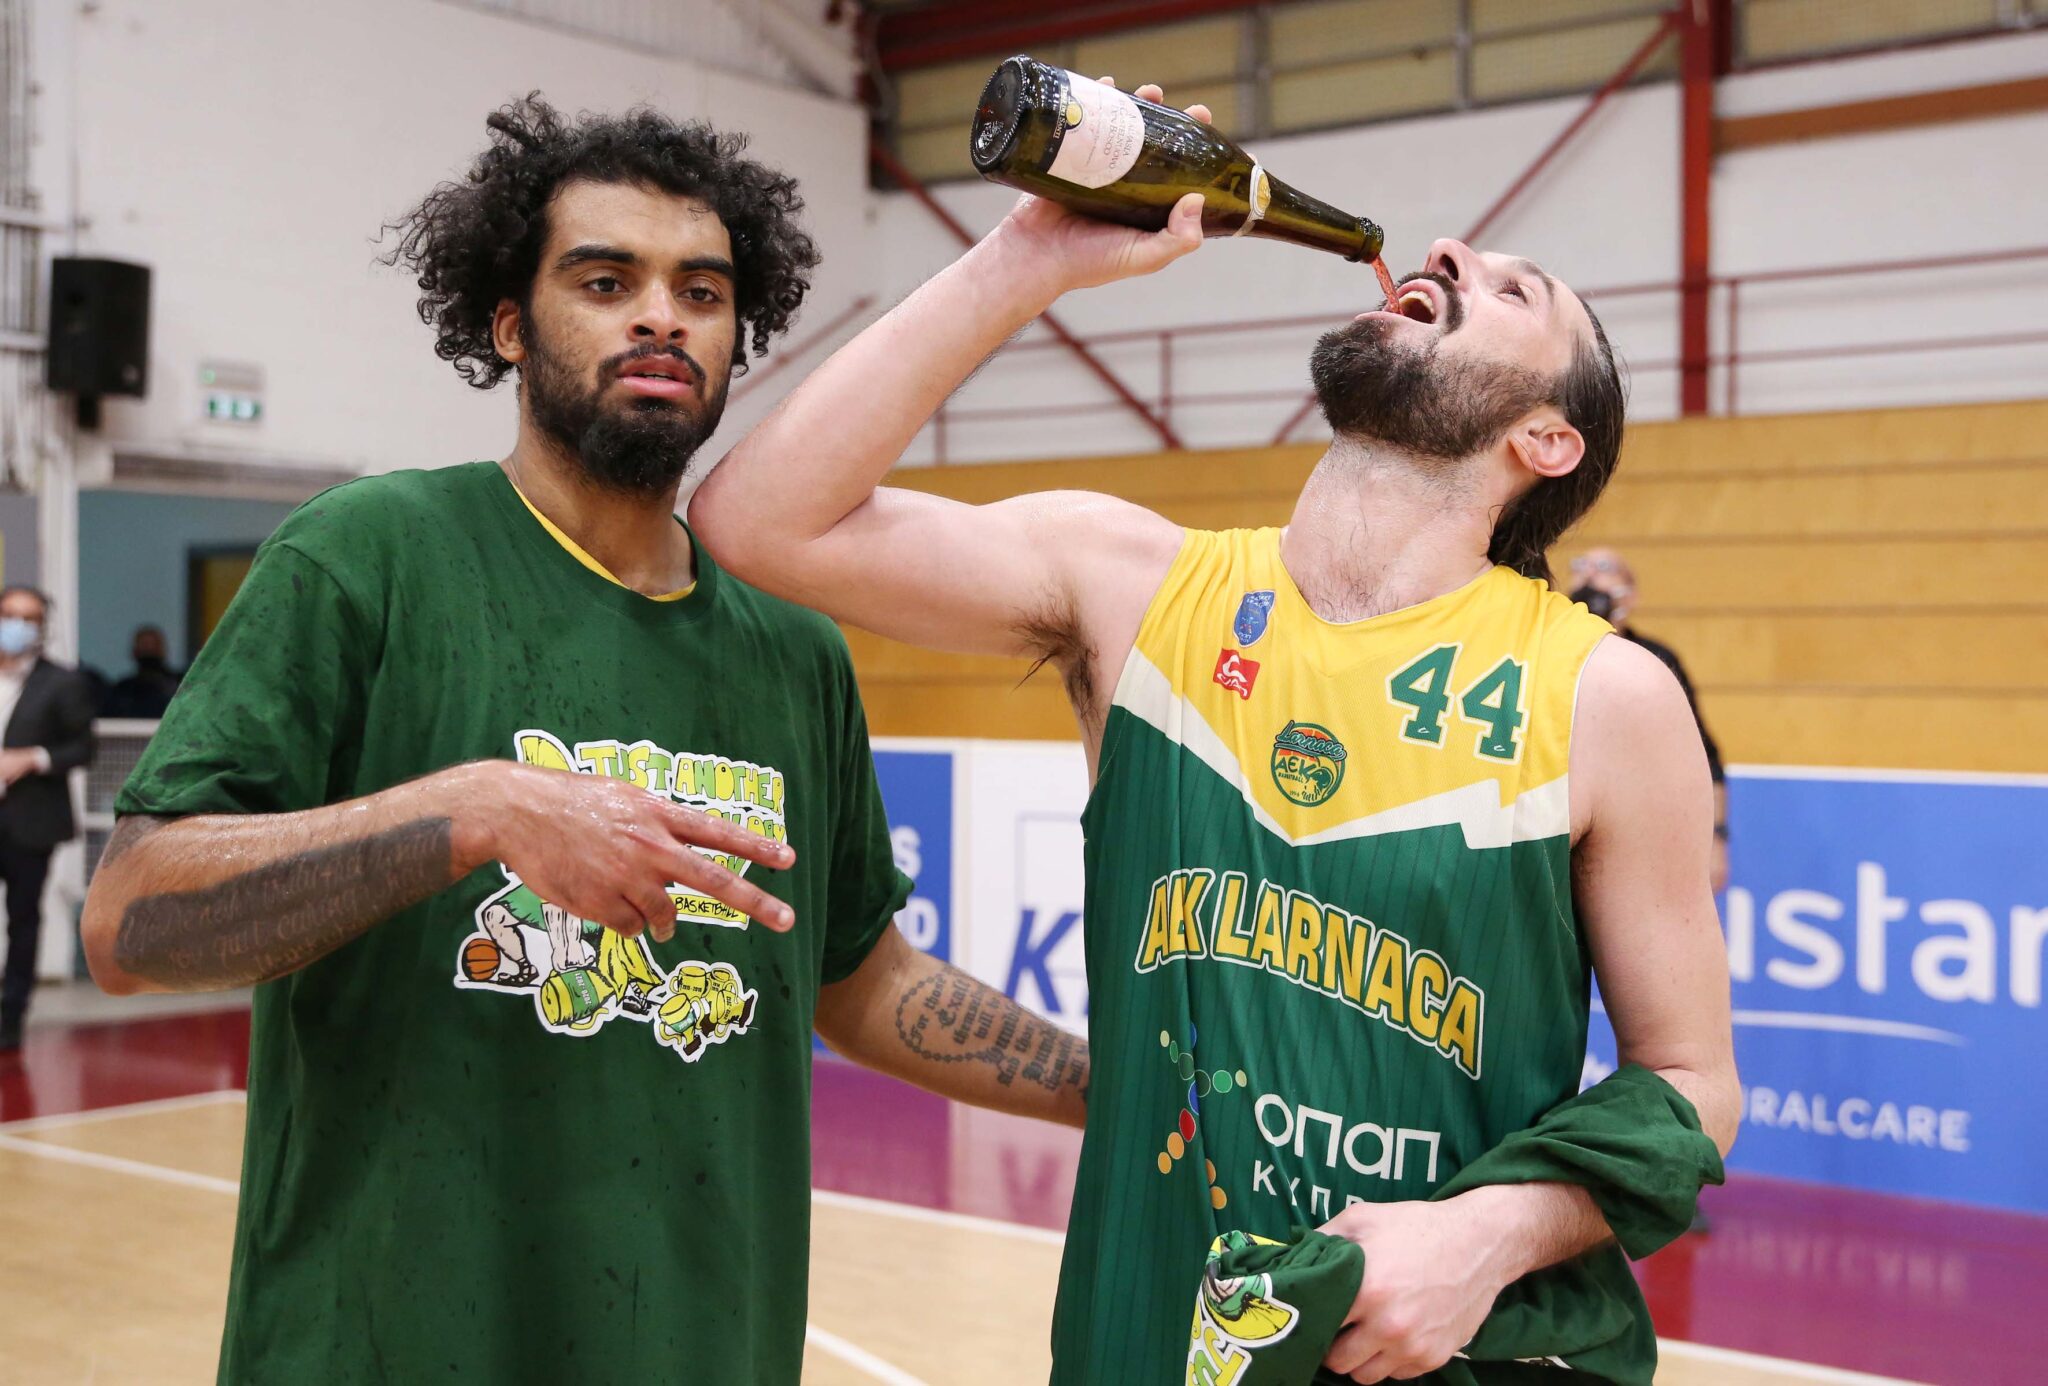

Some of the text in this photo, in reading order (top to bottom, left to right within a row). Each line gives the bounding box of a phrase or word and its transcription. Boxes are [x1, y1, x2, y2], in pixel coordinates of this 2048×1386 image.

[1053, 119, 1066, 139] SANTI
[1384, 641, 1529, 766] 44
[1274, 720, 1347, 760] Larnaca
[675, 757, 783, 816] ANOTHER
[1275, 755, 1317, 780] AEK
[674, 896, 740, 918] BASKETBALL
[1210, 870, 1484, 1081] LARNACA
